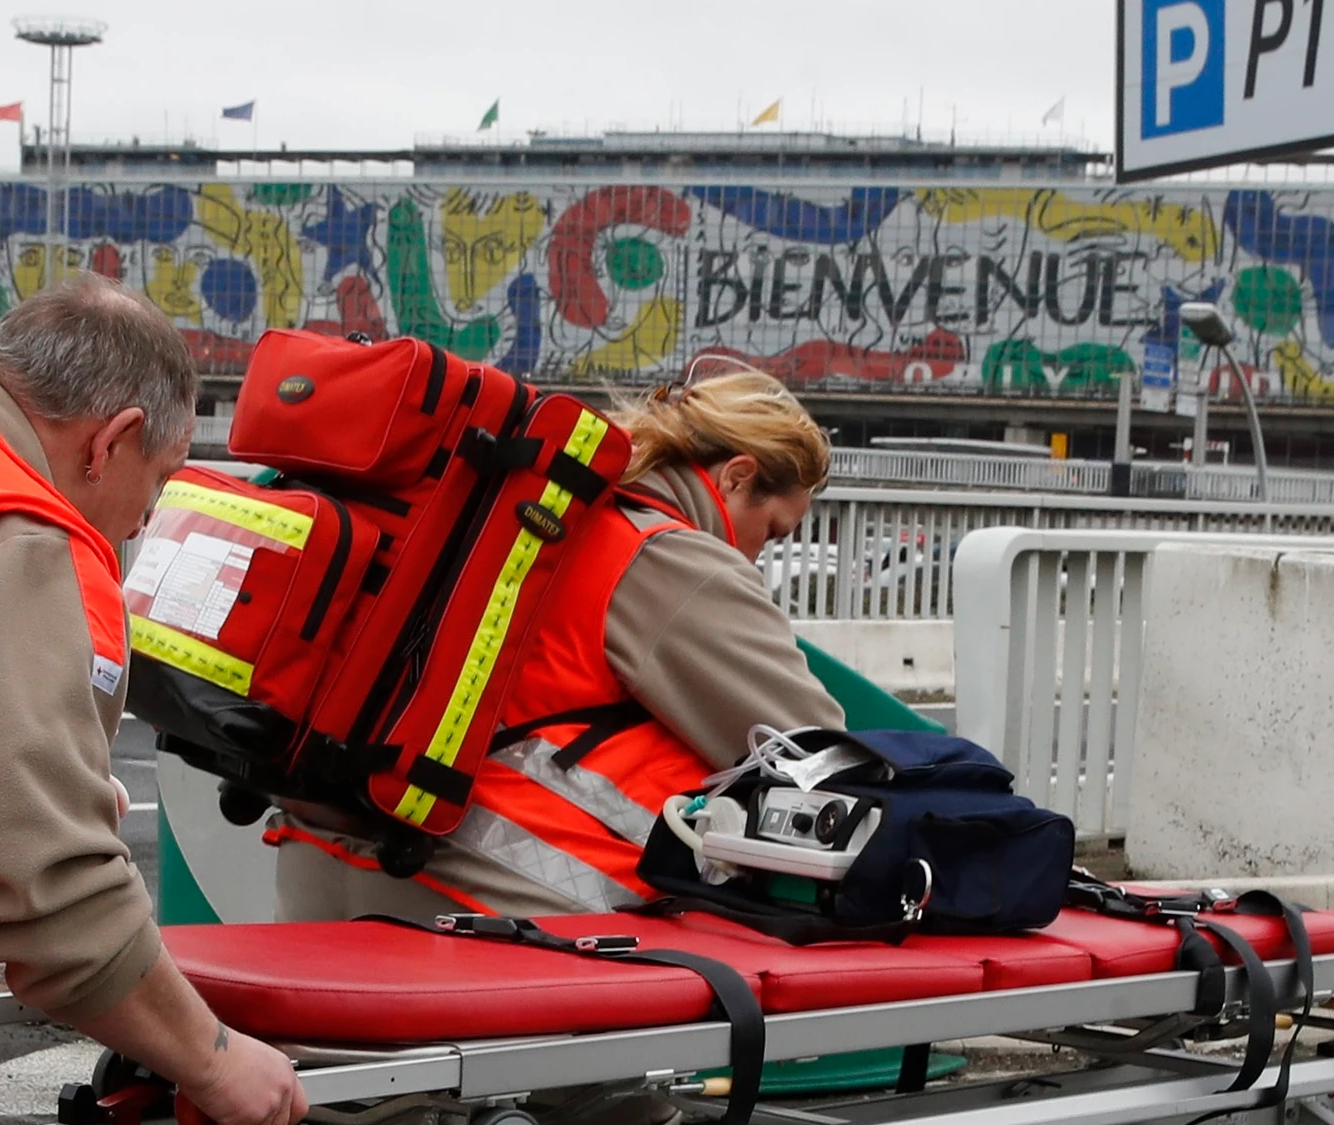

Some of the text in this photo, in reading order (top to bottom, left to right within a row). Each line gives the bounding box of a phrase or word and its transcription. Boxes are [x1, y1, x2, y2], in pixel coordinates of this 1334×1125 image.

[1155, 0, 1325, 128] P P1
[695, 248, 1160, 328] BIENVENUE
[523, 504, 561, 537] DIMATEX
